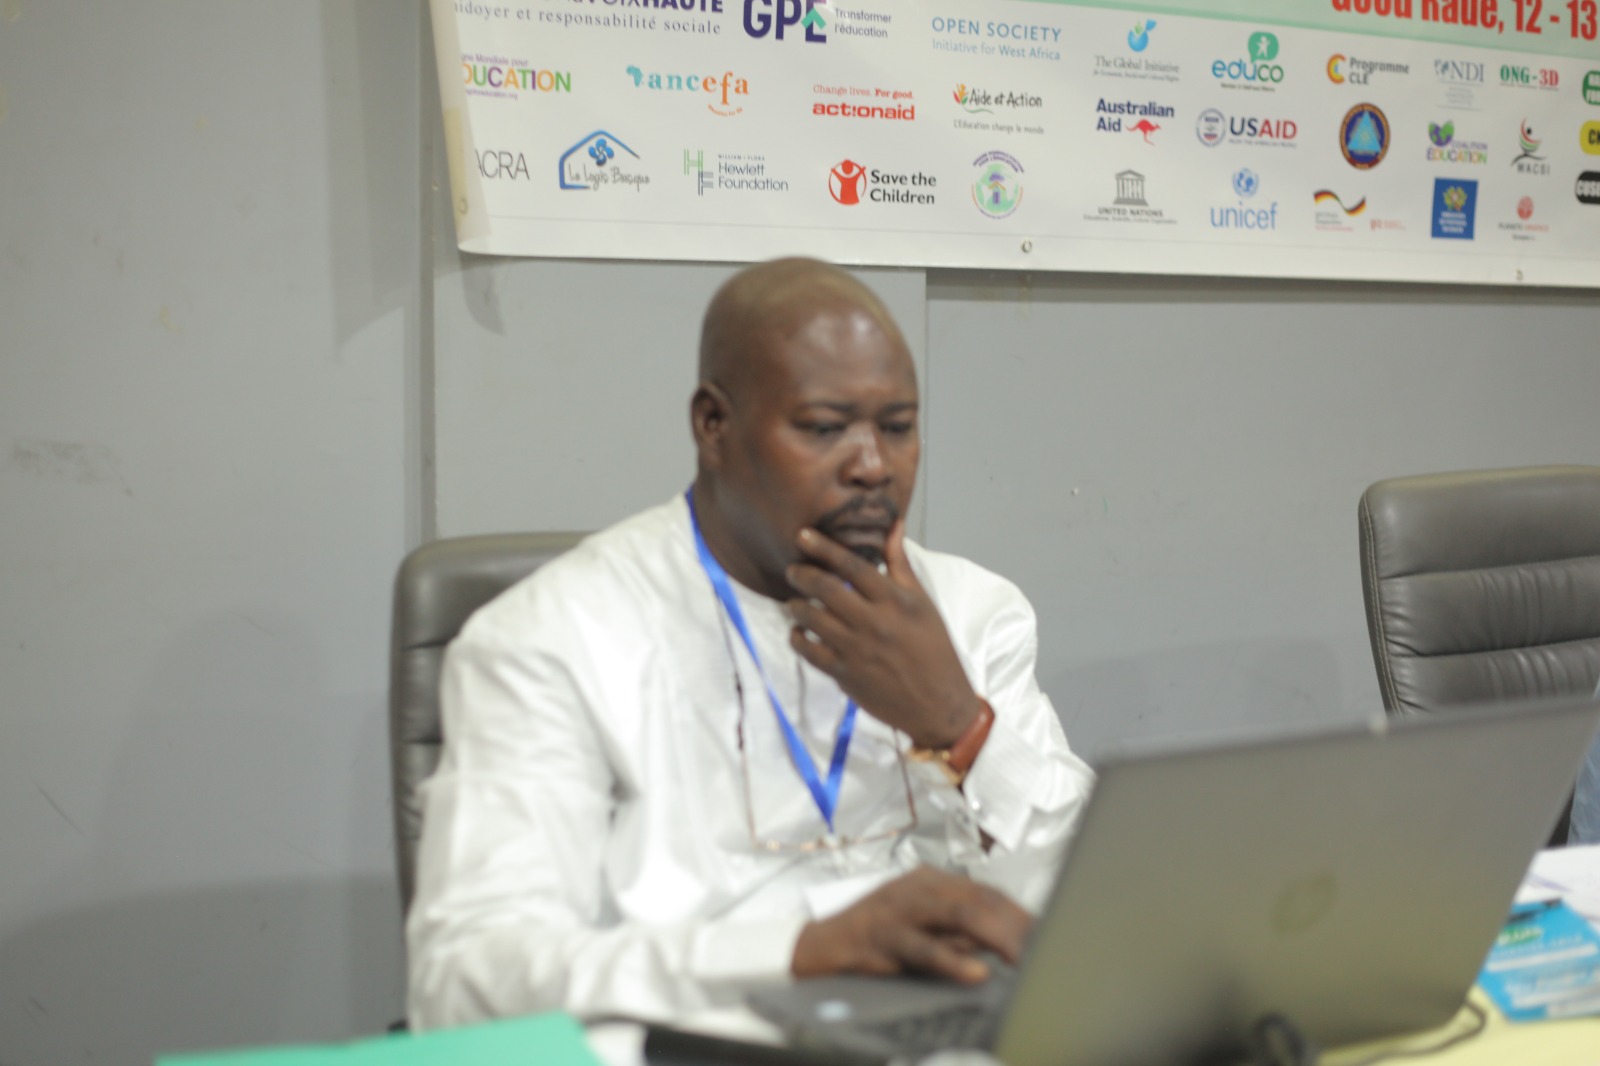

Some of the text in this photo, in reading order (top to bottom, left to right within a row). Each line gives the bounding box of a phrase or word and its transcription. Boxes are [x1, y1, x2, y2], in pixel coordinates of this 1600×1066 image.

[516, 9, 531, 20] et
[539, 9, 657, 30] responsabilité
[663, 20, 721, 34] sociale
[743, 0, 827, 43] GPE
[835, 8, 891, 23] Transformer
[1512, 0, 1542, 34] 12
[1566, 0, 1598, 41] 13
[834, 24, 888, 38] l'éducation
[932, 16, 1061, 42] OPEN SOCIETY
[933, 39, 1060, 61] Initiative for West Africa
[1093, 55, 1180, 73] The Global Initiative
[1211, 58, 1284, 83] educo
[1349, 56, 1409, 75] Programme
[1450, 60, 1484, 82] NDI
[647, 71, 749, 106] ancefa
[813, 84, 847, 98] Change
[875, 88, 890, 98] For
[969, 87, 1043, 108] Aide et Action
[1096, 98, 1175, 118] Australian
[1096, 116, 1121, 132] Aid
[1229, 116, 1298, 140] USAID
[718, 162, 765, 176] Hewlett
[870, 169, 937, 187] Save the
[718, 176, 789, 192] Foundation
[870, 188, 936, 205] Children
[1098, 206, 1163, 218] UNITED NATIONS
[1210, 200, 1279, 229] unicef
